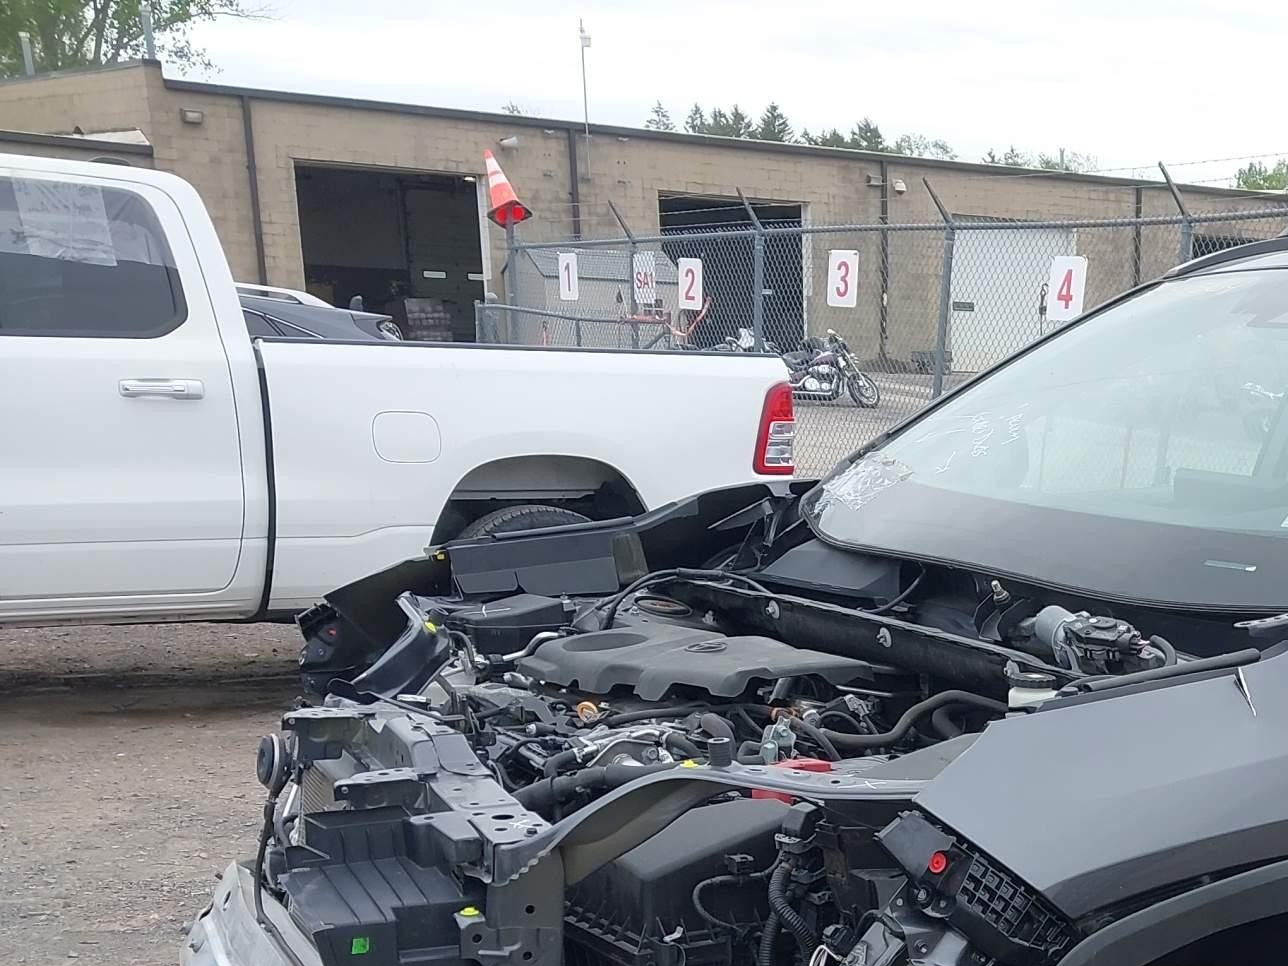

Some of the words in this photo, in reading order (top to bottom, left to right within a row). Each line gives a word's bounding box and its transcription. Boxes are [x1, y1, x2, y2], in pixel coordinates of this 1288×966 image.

[564, 261, 571, 292] 1
[684, 268, 695, 300] 2
[835, 260, 850, 298] 3
[1056, 268, 1073, 309] 4
